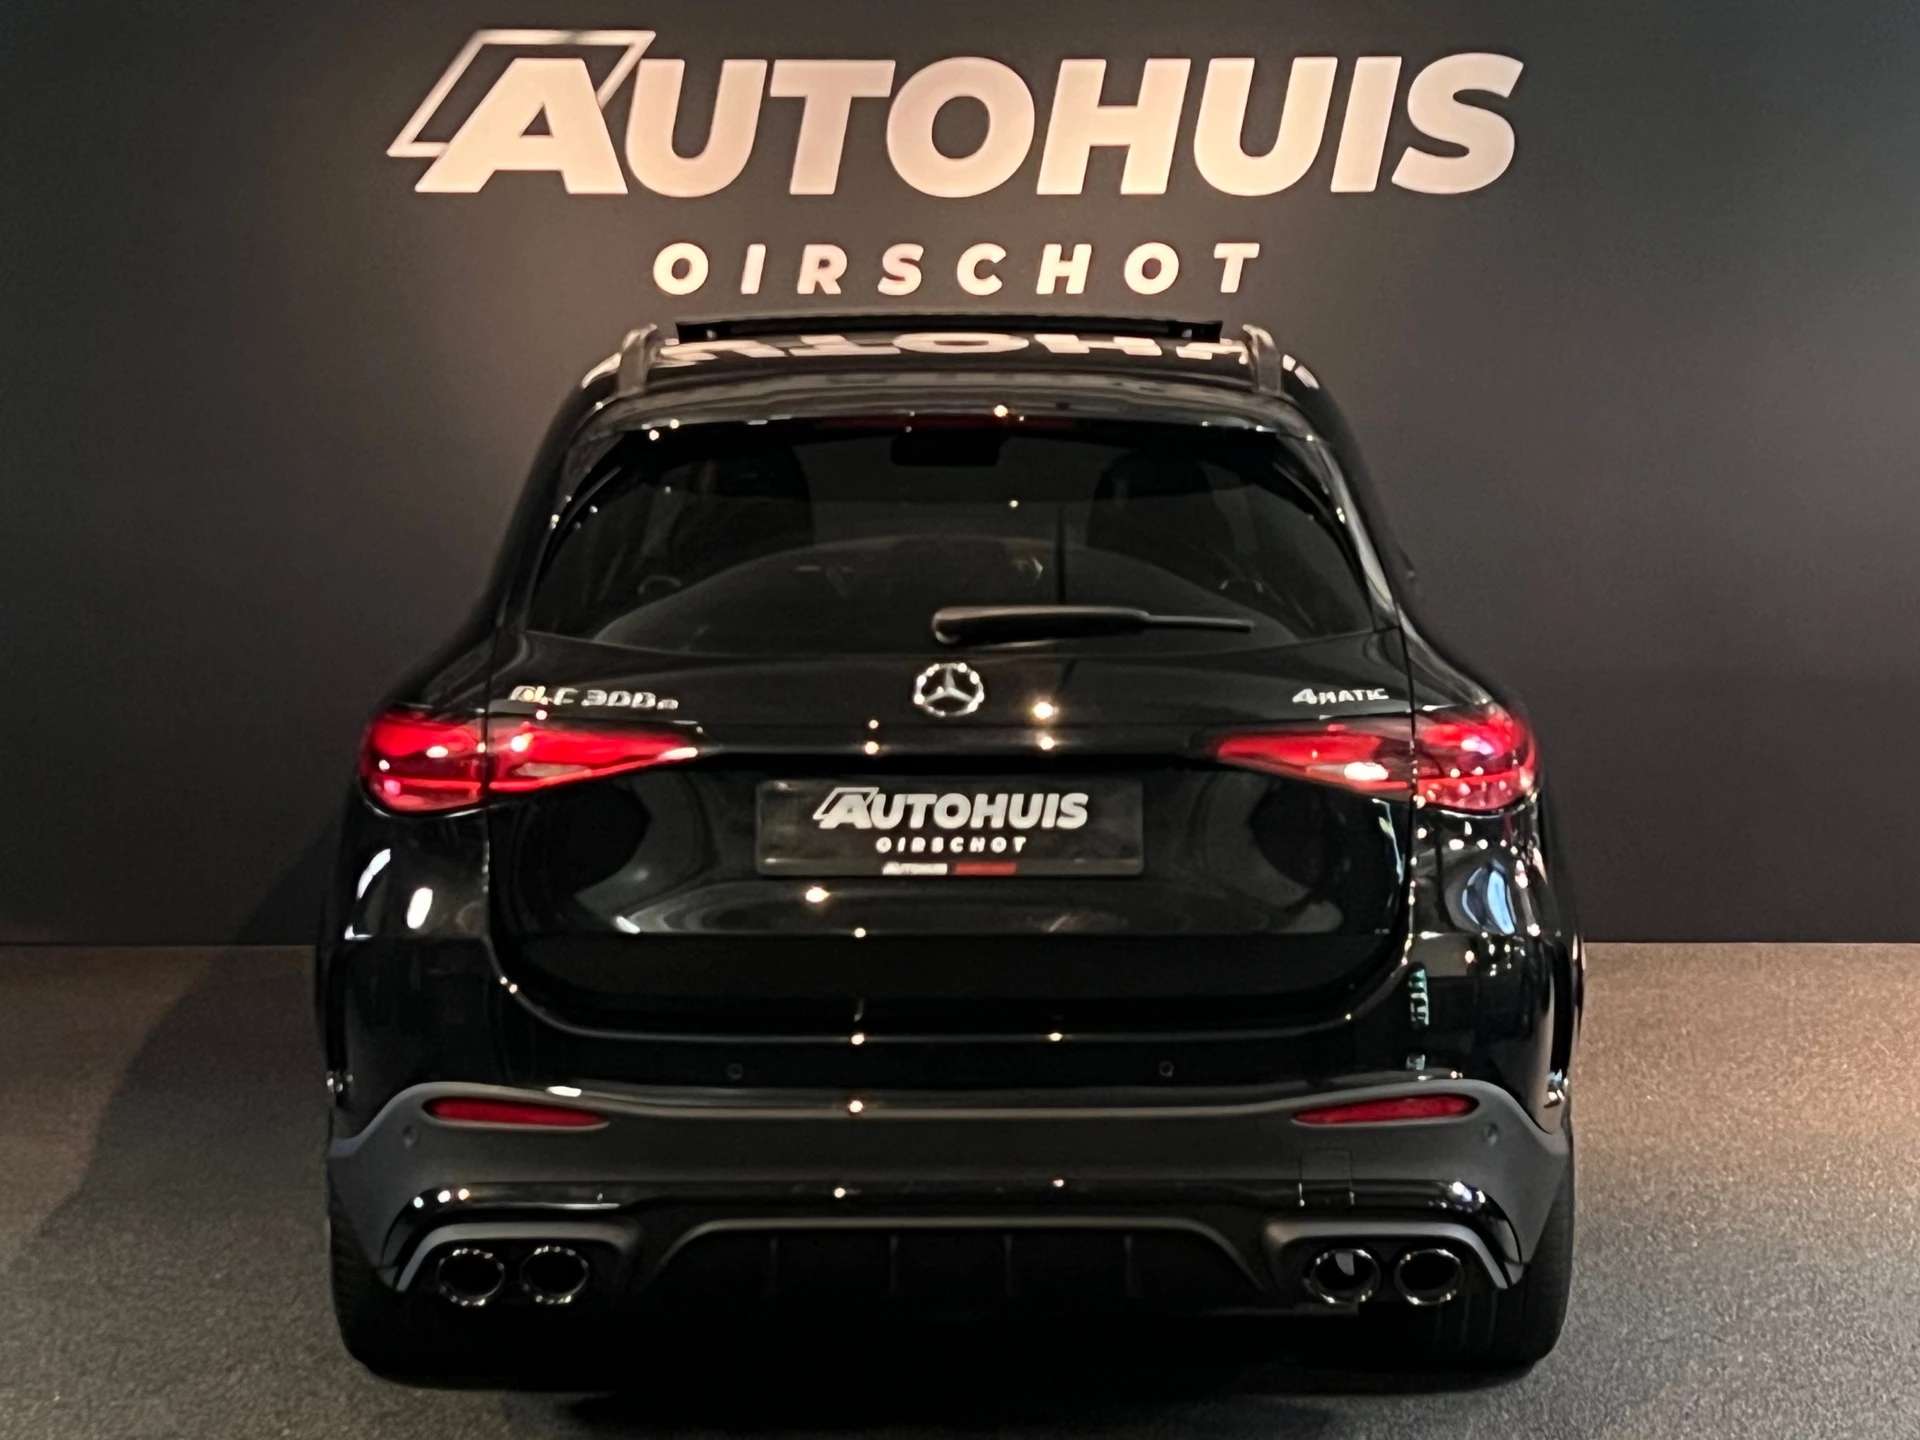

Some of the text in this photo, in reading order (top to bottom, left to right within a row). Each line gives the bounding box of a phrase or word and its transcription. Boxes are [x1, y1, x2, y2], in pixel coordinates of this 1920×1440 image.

[405, 48, 1525, 198] AUTOHUIS
[652, 242, 1261, 297] OIRSCHOT
[817, 789, 1089, 830] AUTOHUIS
[875, 836, 1028, 854] OIRSCHOT
